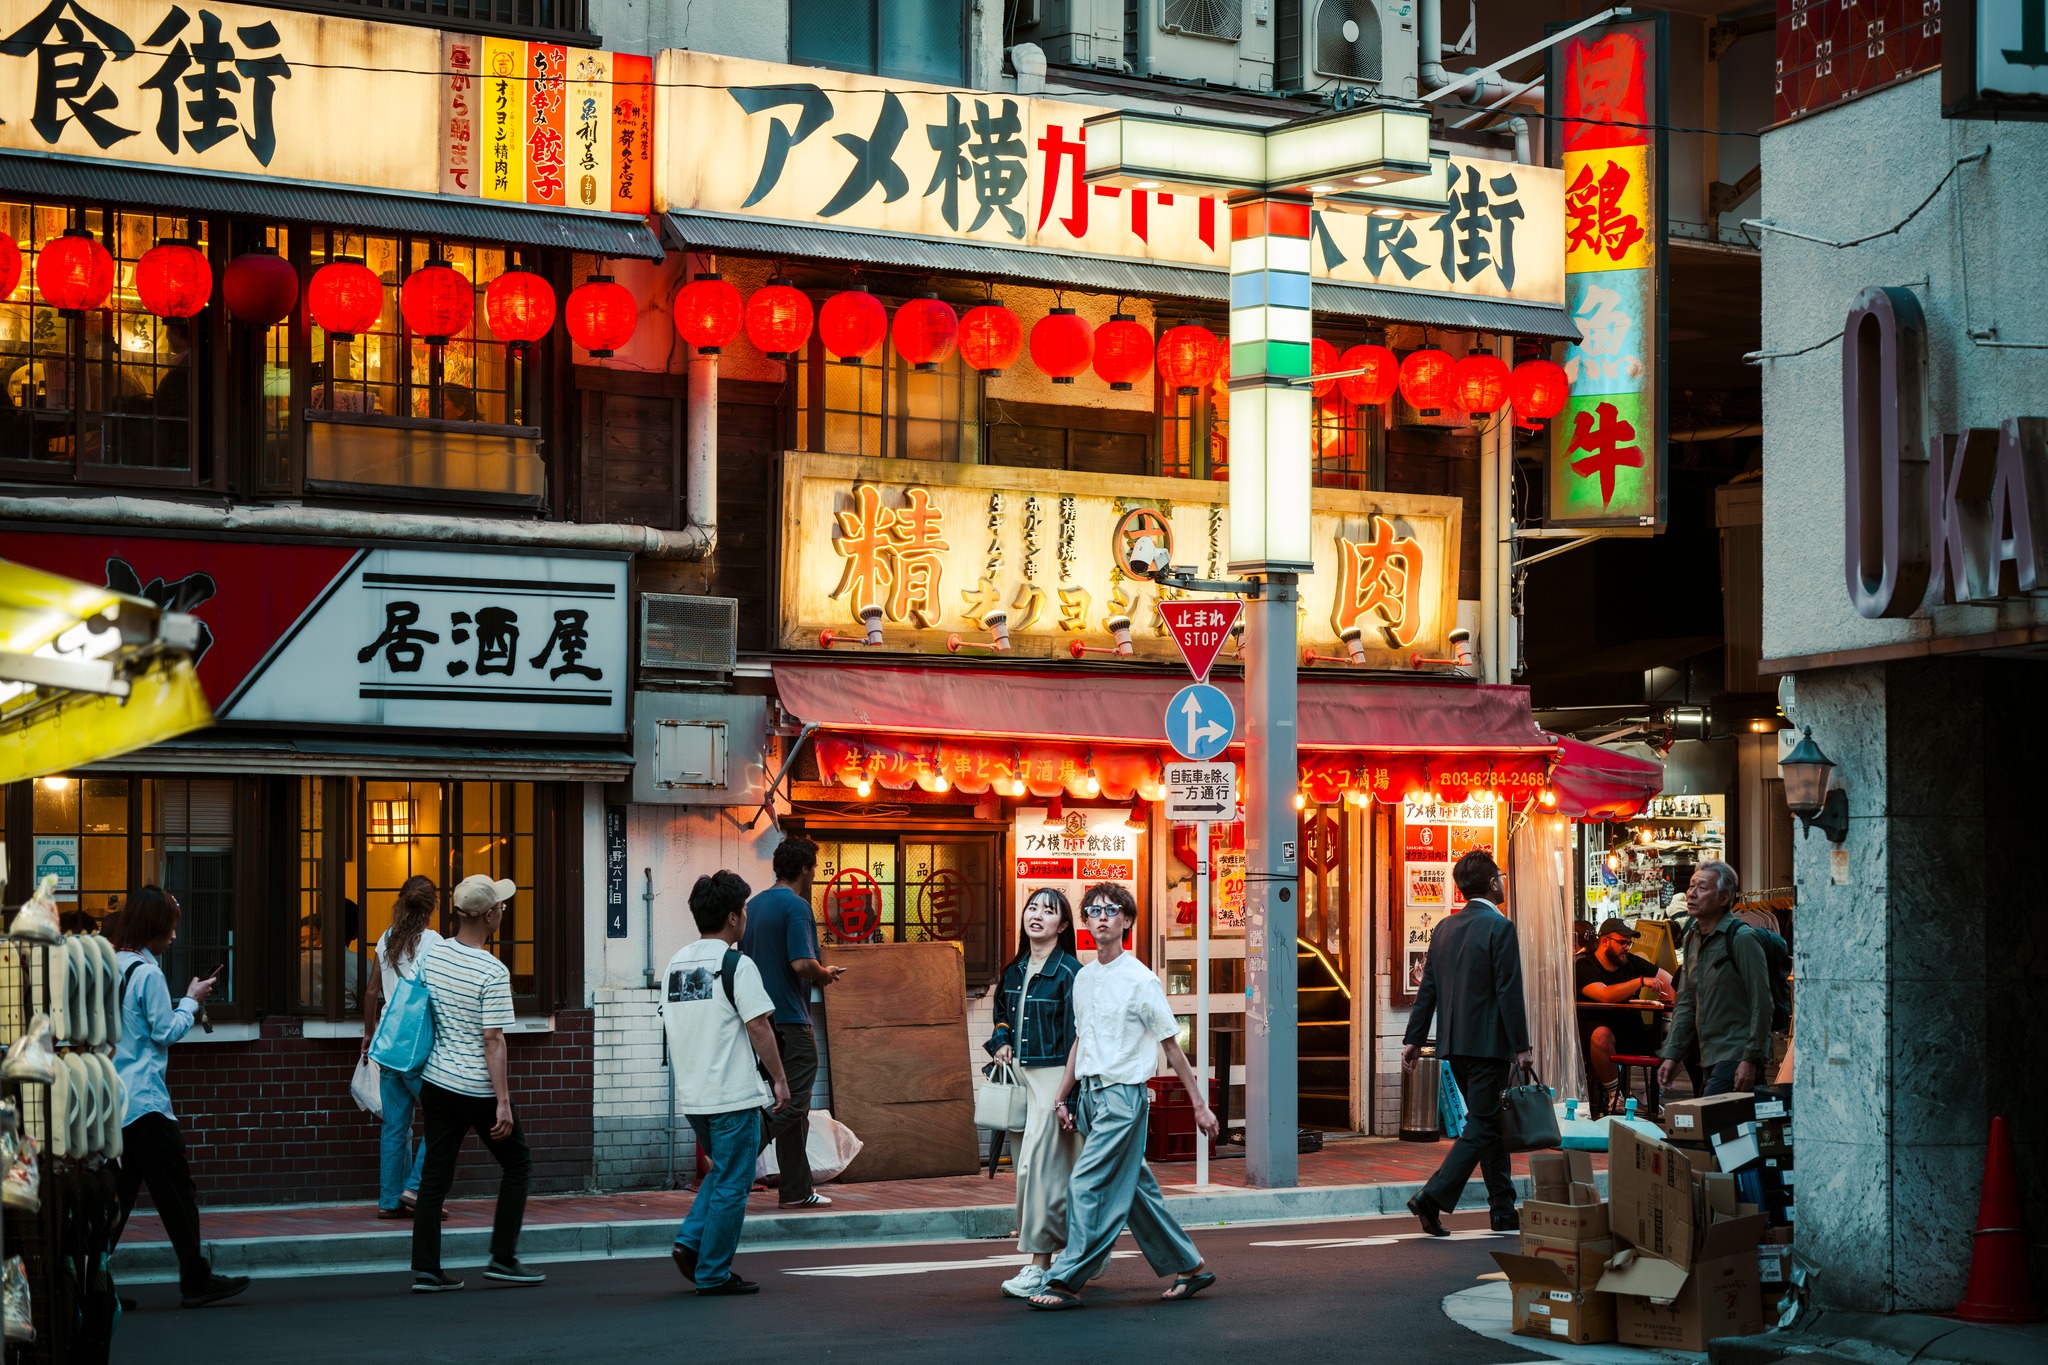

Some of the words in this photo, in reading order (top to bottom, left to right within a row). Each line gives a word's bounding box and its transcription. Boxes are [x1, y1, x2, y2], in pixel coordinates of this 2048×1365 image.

[0, 0, 292, 168] 食街
[450, 44, 471, 190] 昼から朝まで
[494, 79, 509, 192] オクヨシ精肉所
[528, 51, 565, 200] ちょい呑み餃子
[1566, 160, 1645, 262] 鶏
[1568, 285, 1642, 381] 魚
[1566, 402, 1644, 511] 牛
[1843, 286, 2038, 619] OKA
[838, 484, 950, 630] 精
[1336, 515, 1425, 647] 肉
[987, 493, 1004, 579] 生キムチ
[1024, 496, 1042, 581] ホルモン串
[358, 600, 604, 682] 居酒屋
[1176, 609, 1226, 628] 止まれ
[1184, 632, 1219, 647] STOP
[1170, 785, 1230, 800] 一方通行
[1171, 769, 1229, 783] 自転車を除く
[1452, 770, 1545, 787] 03-6284-2468
[612, 836, 623, 905] 上野六丁目
[822, 861, 835, 876] 品
[872, 861, 885, 879] 質
[916, 862, 929, 878] 品
[613, 915, 621, 930] 4
[821, 929, 834, 945] 本
[871, 930, 885, 944] 位
[916, 930, 928, 943] 本
